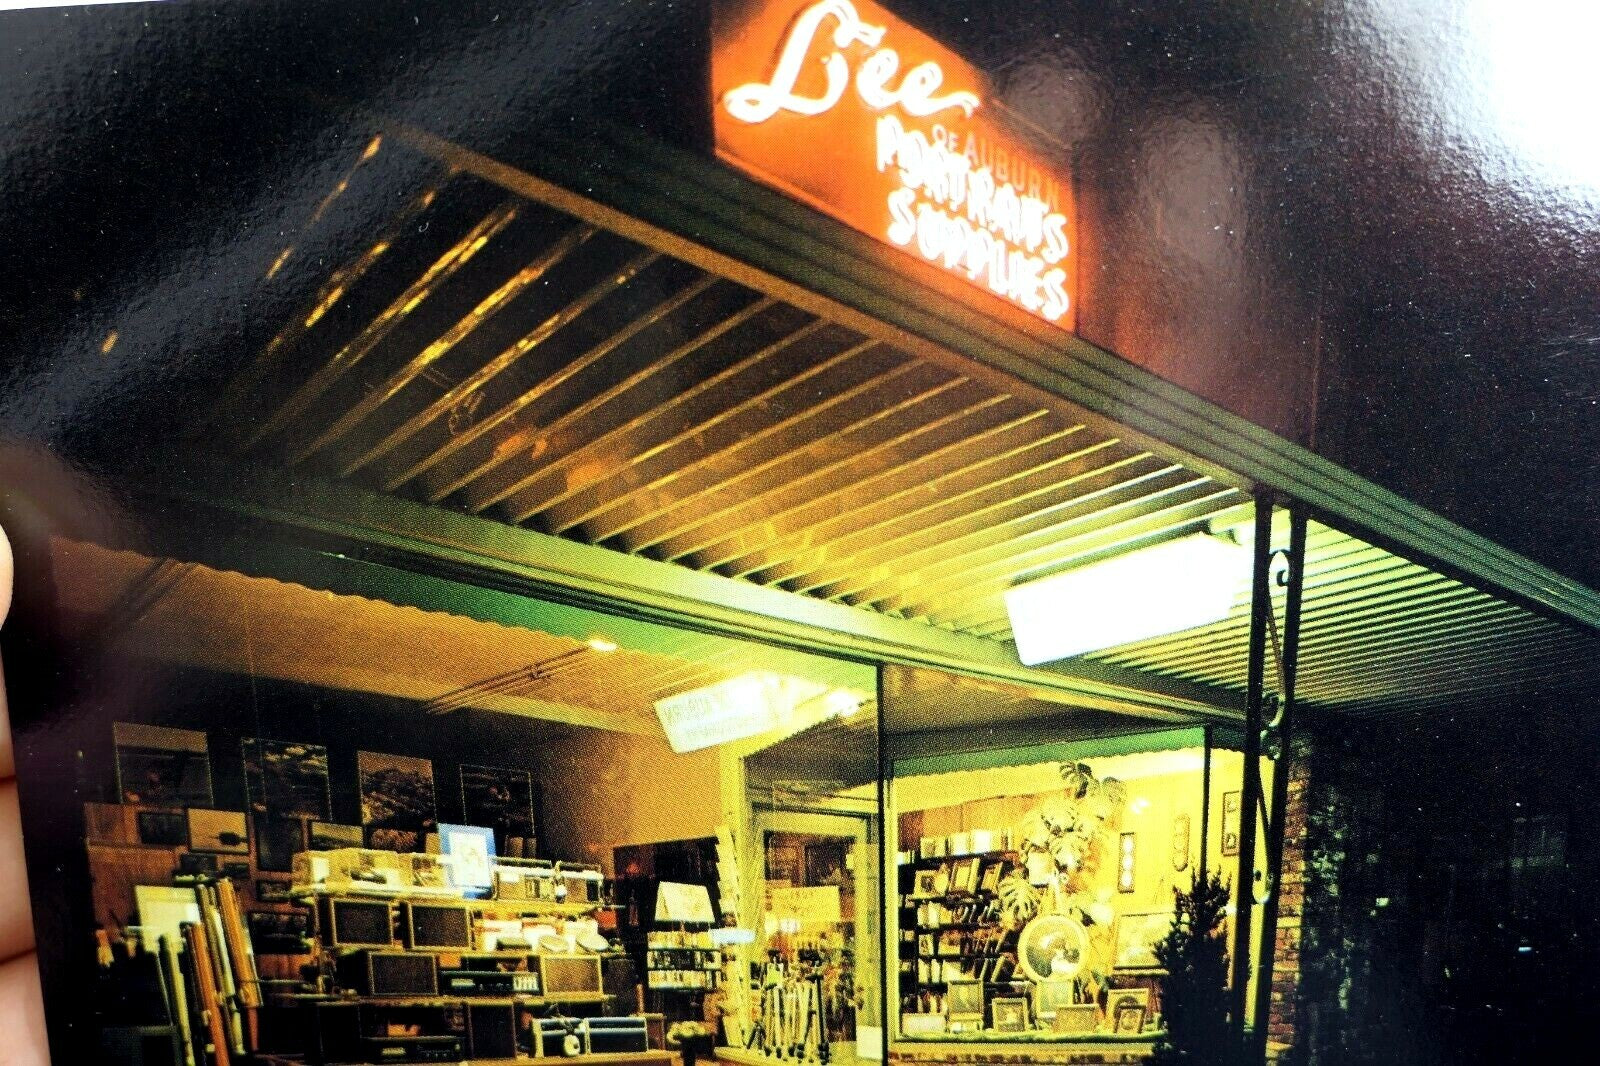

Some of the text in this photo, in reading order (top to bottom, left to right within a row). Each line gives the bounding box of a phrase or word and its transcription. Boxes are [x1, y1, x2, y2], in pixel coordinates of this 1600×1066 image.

[723, 0, 980, 123] Lee
[963, 131, 1060, 213] AUBURN
[887, 187, 1070, 321] SUPPLIES
